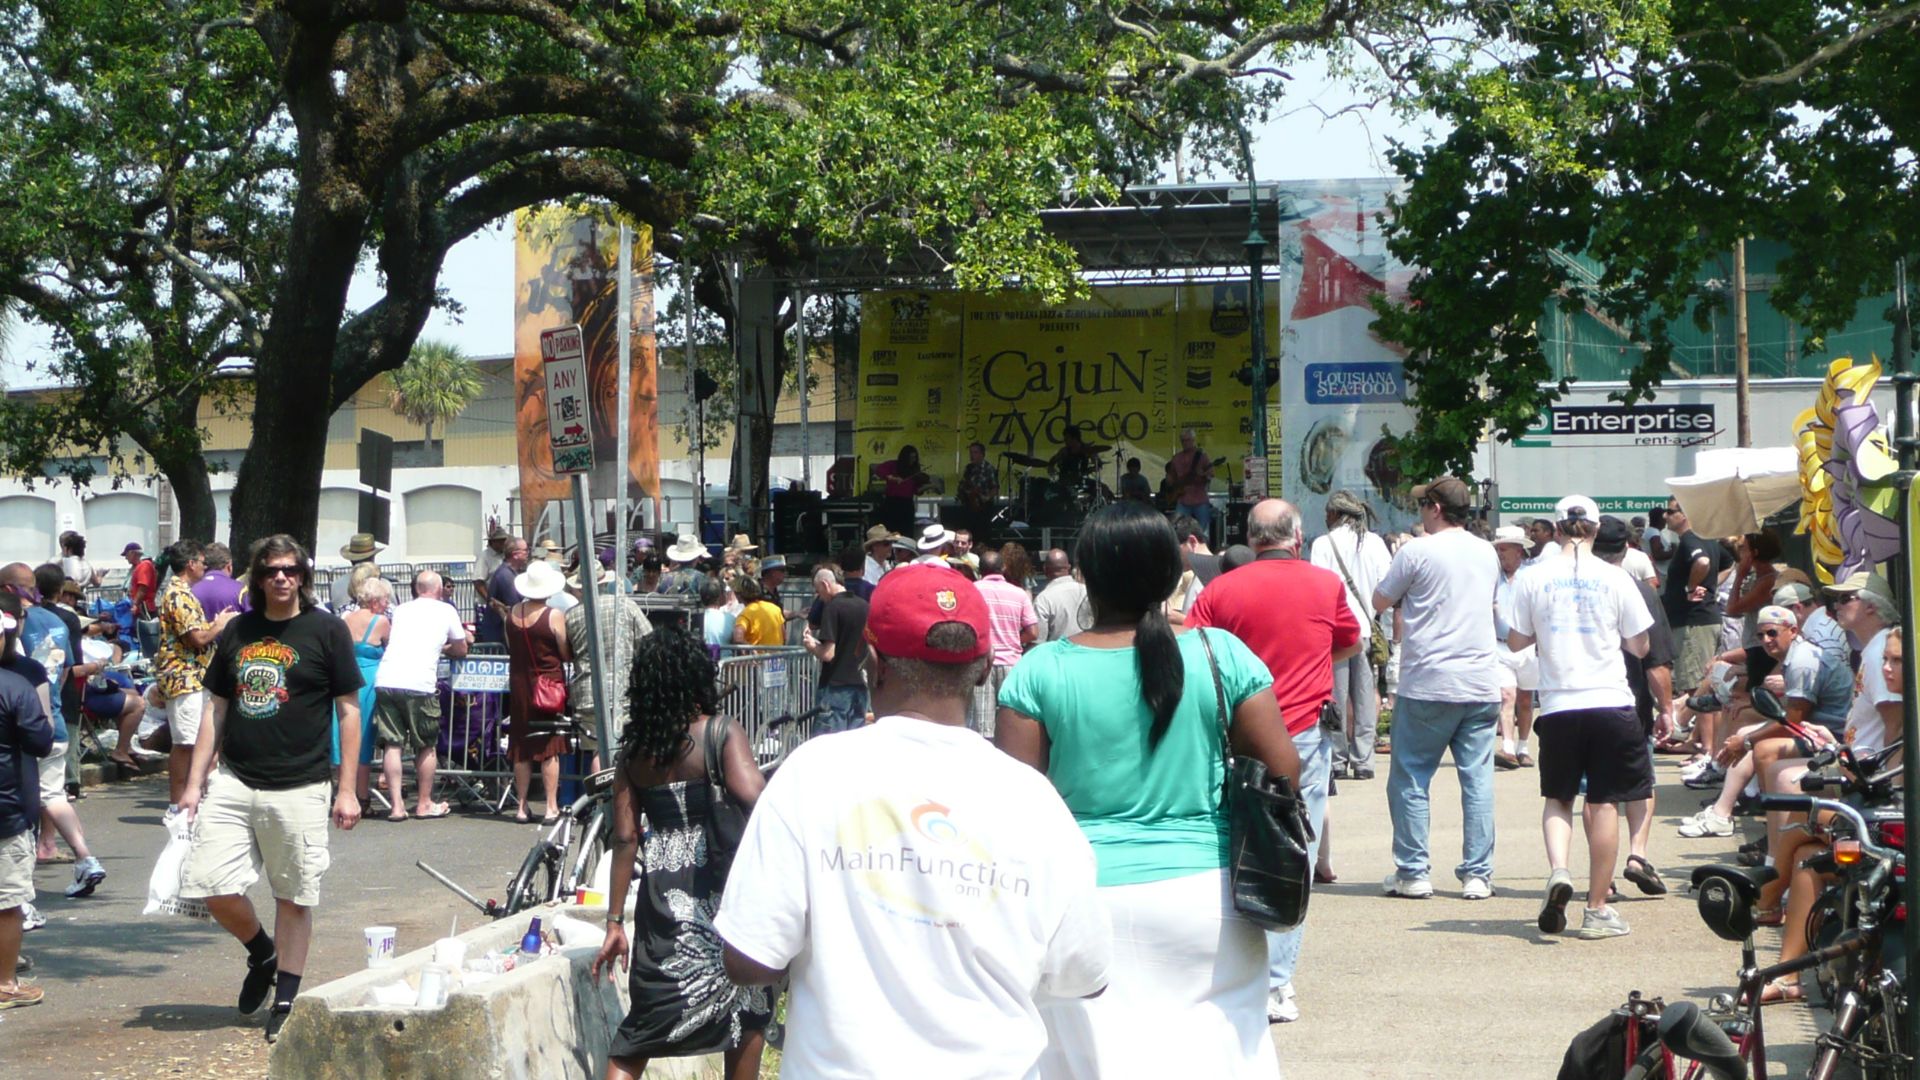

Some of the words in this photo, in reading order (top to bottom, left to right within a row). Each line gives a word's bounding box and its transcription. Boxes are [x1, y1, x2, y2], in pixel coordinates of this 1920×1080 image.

[1039, 323, 1080, 331] PRESENTS
[543, 335, 555, 359] NO
[555, 334, 580, 354] PARKING
[553, 368, 577, 390] ANY
[1313, 370, 1394, 386] LOUISIANA
[1317, 382, 1397, 397] SEAFOOD
[554, 399, 582, 420] TE
[1553, 408, 1713, 434] Enterprise
[1635, 434, 1713, 446] rent-a-car
[1626, 500, 1669, 510] Rental
